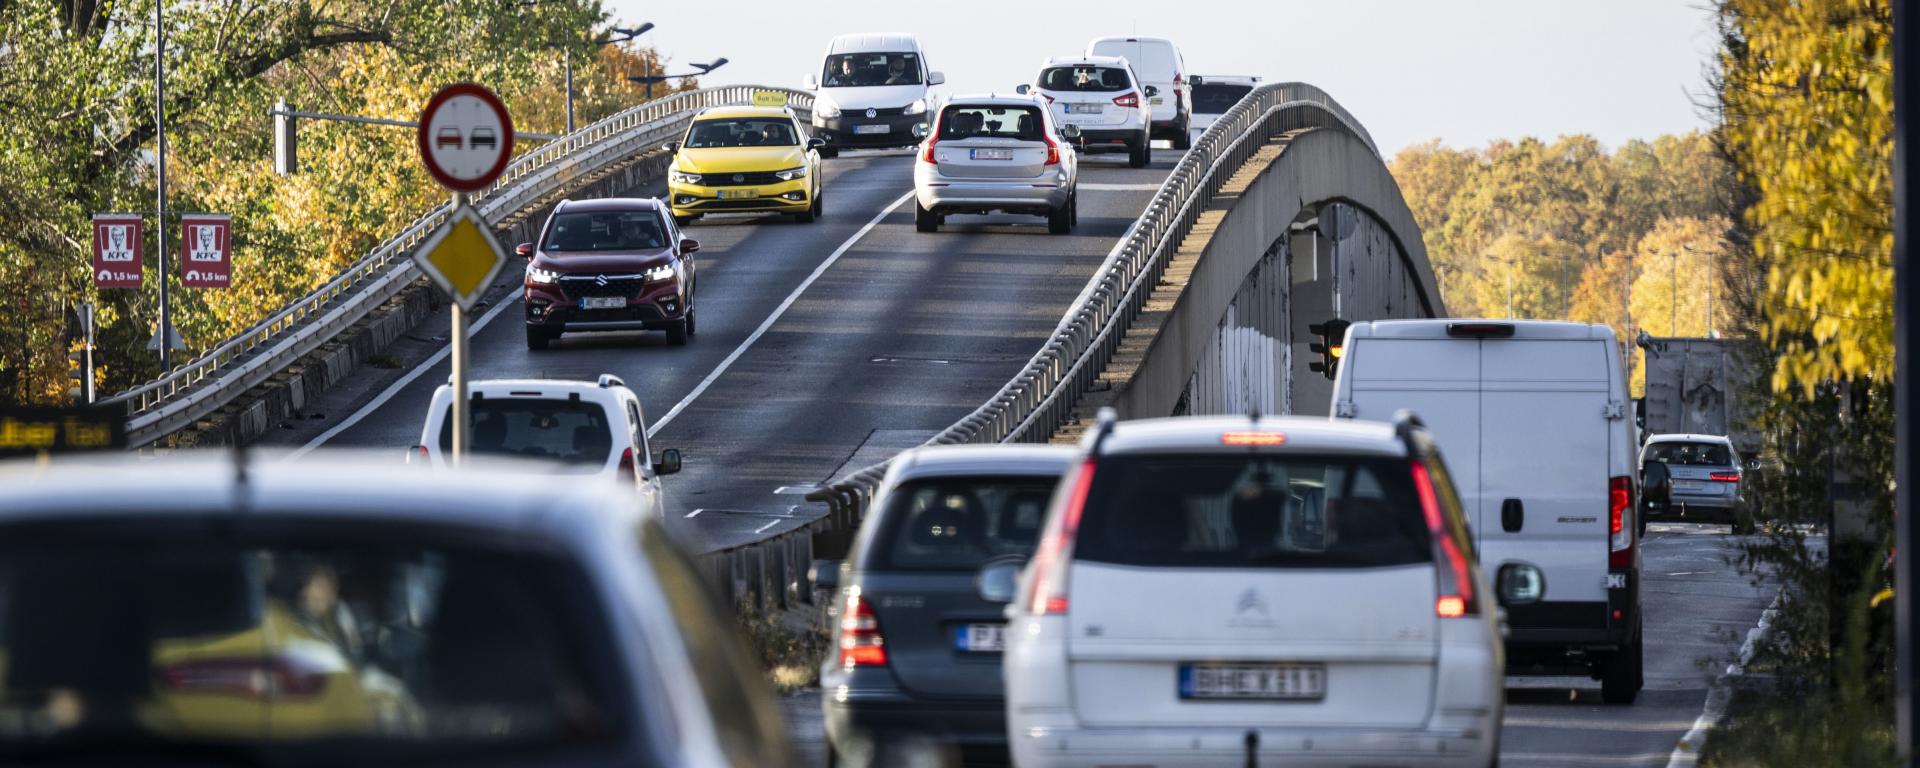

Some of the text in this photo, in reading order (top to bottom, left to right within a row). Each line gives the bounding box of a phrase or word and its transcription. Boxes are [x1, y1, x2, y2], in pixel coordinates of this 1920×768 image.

[107, 251, 129, 260] KFC
[195, 251, 218, 260] KFC
[113, 271, 139, 281] 1,5 km
[200, 271, 228, 281] 1,5 km
